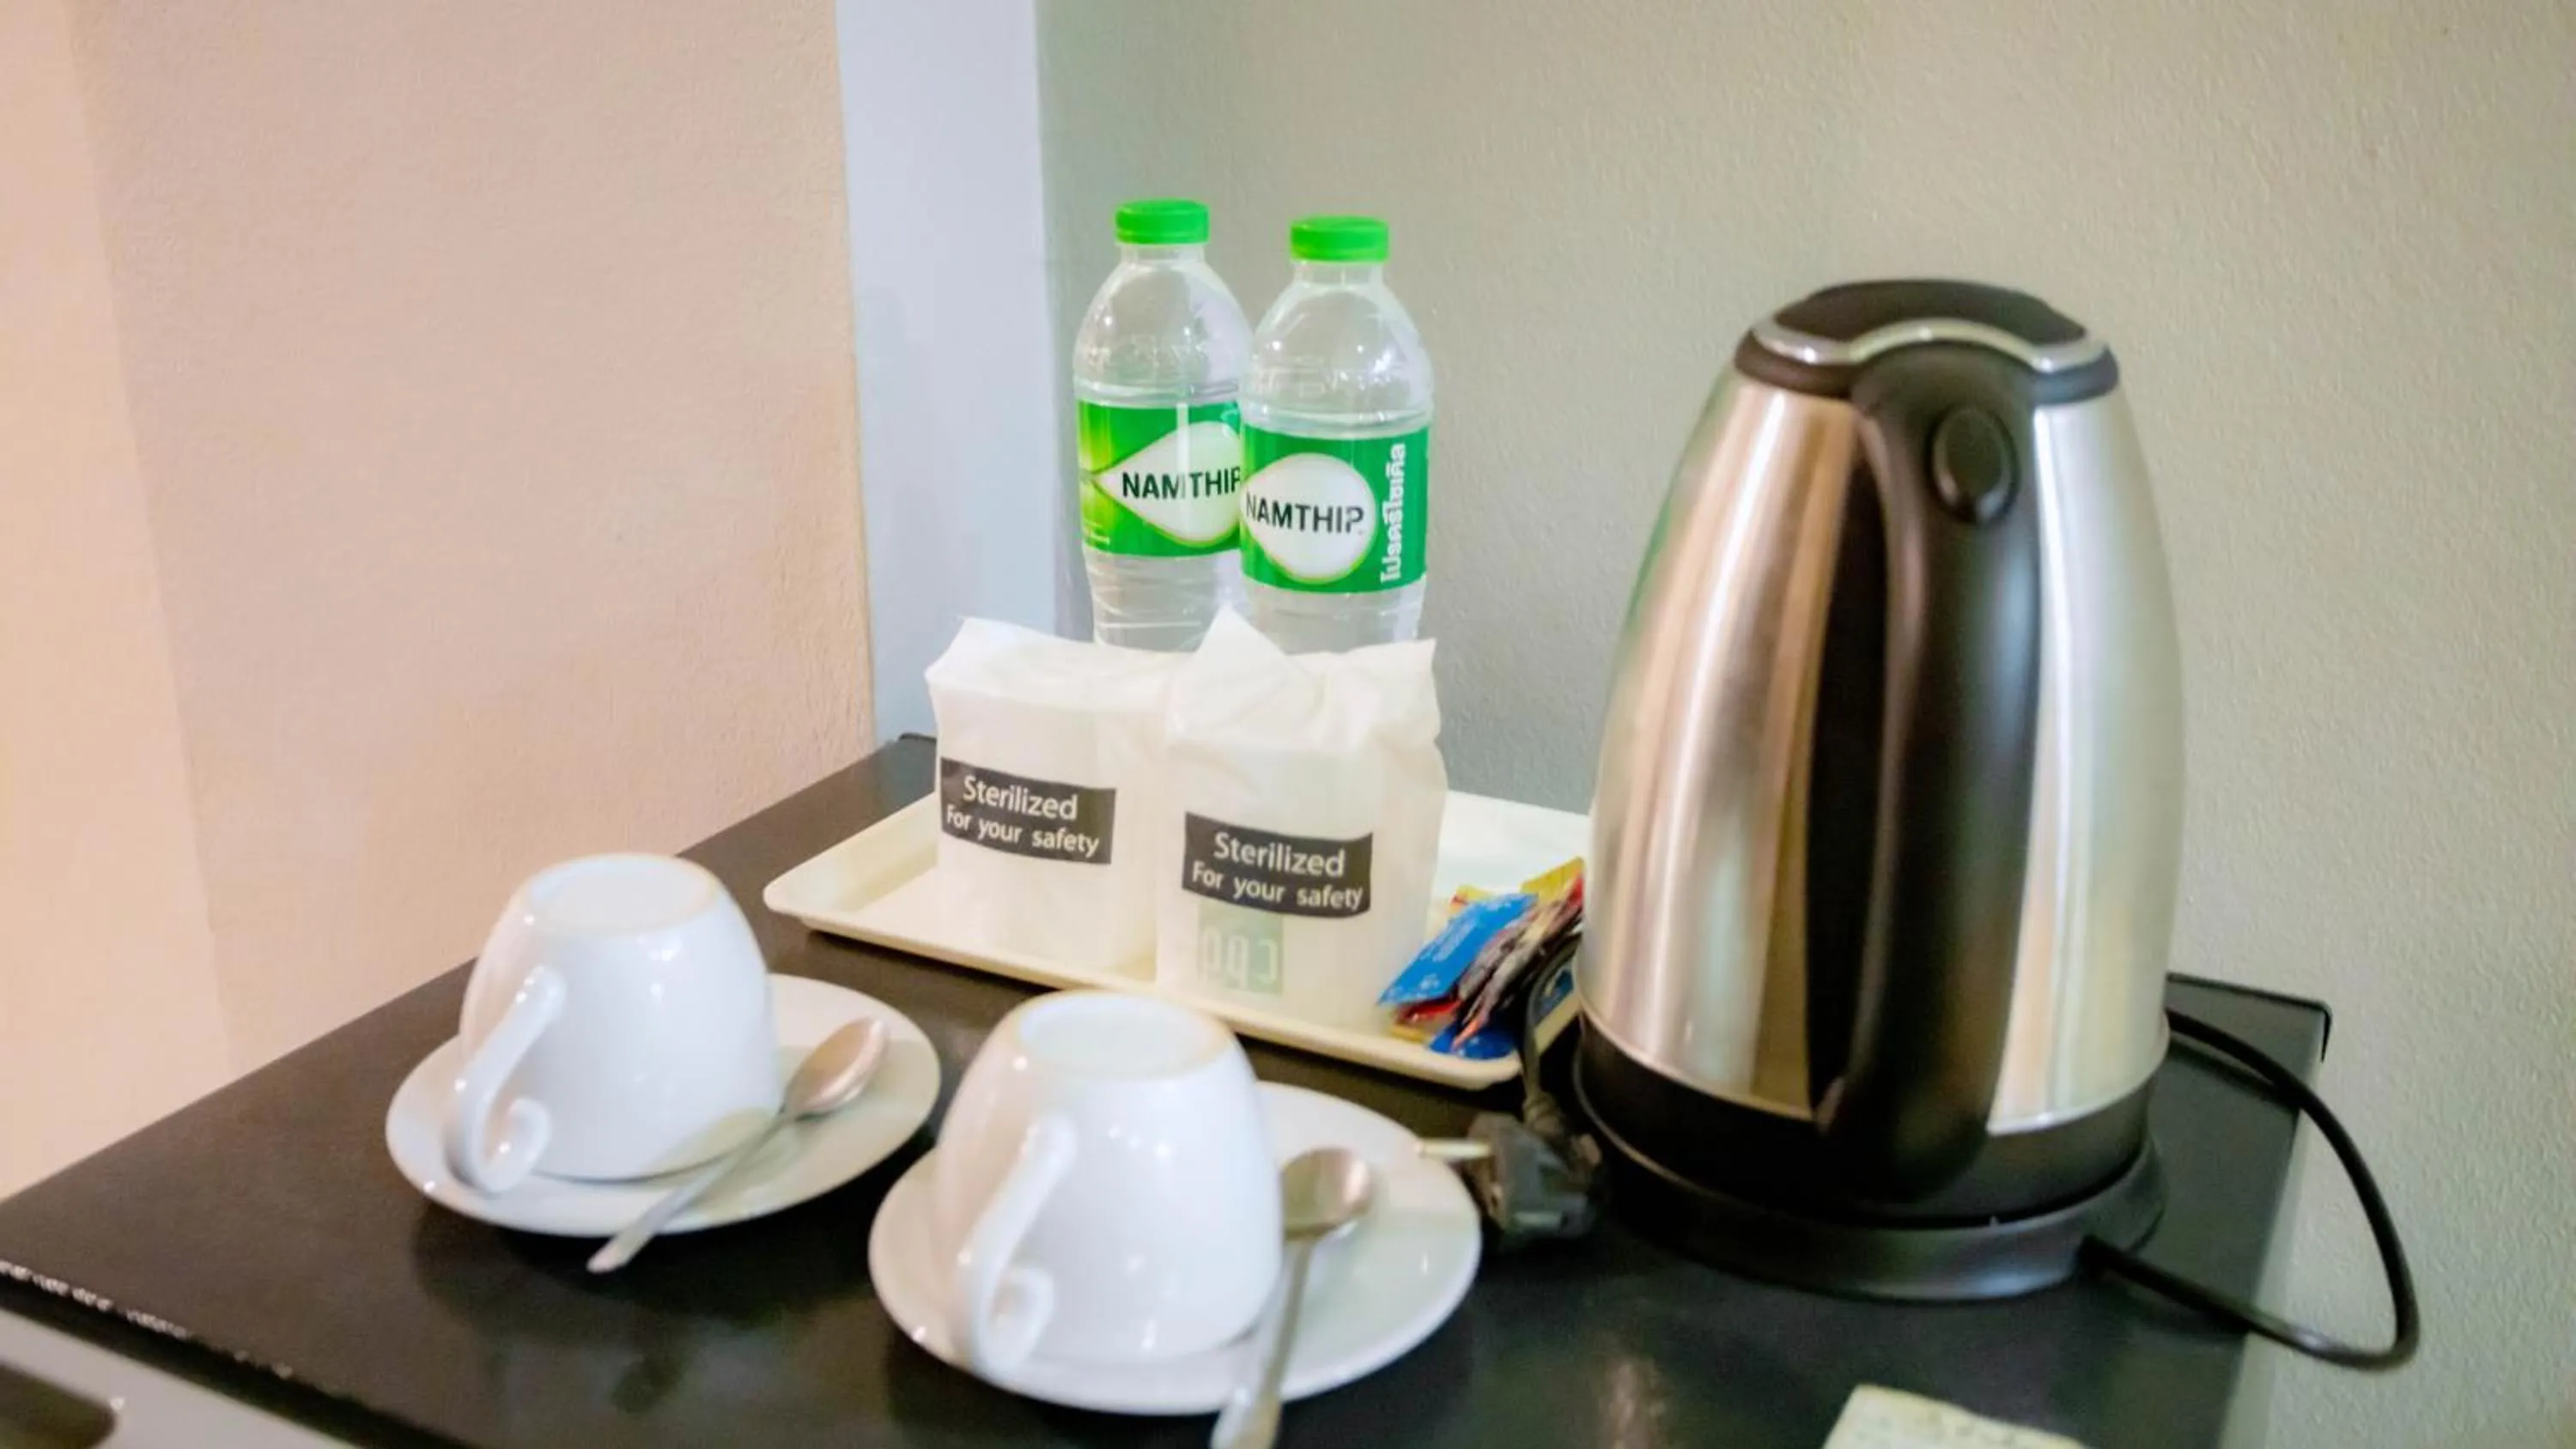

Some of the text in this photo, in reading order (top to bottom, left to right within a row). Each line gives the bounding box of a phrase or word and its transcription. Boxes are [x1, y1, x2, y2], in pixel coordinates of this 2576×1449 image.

[1246, 491, 1364, 534] NAMTHIP
[963, 774, 1078, 820] Sterilized
[946, 803, 1099, 858] For your safety
[1213, 831, 1346, 877] Sterilized
[1192, 860, 1364, 910] For your safety
